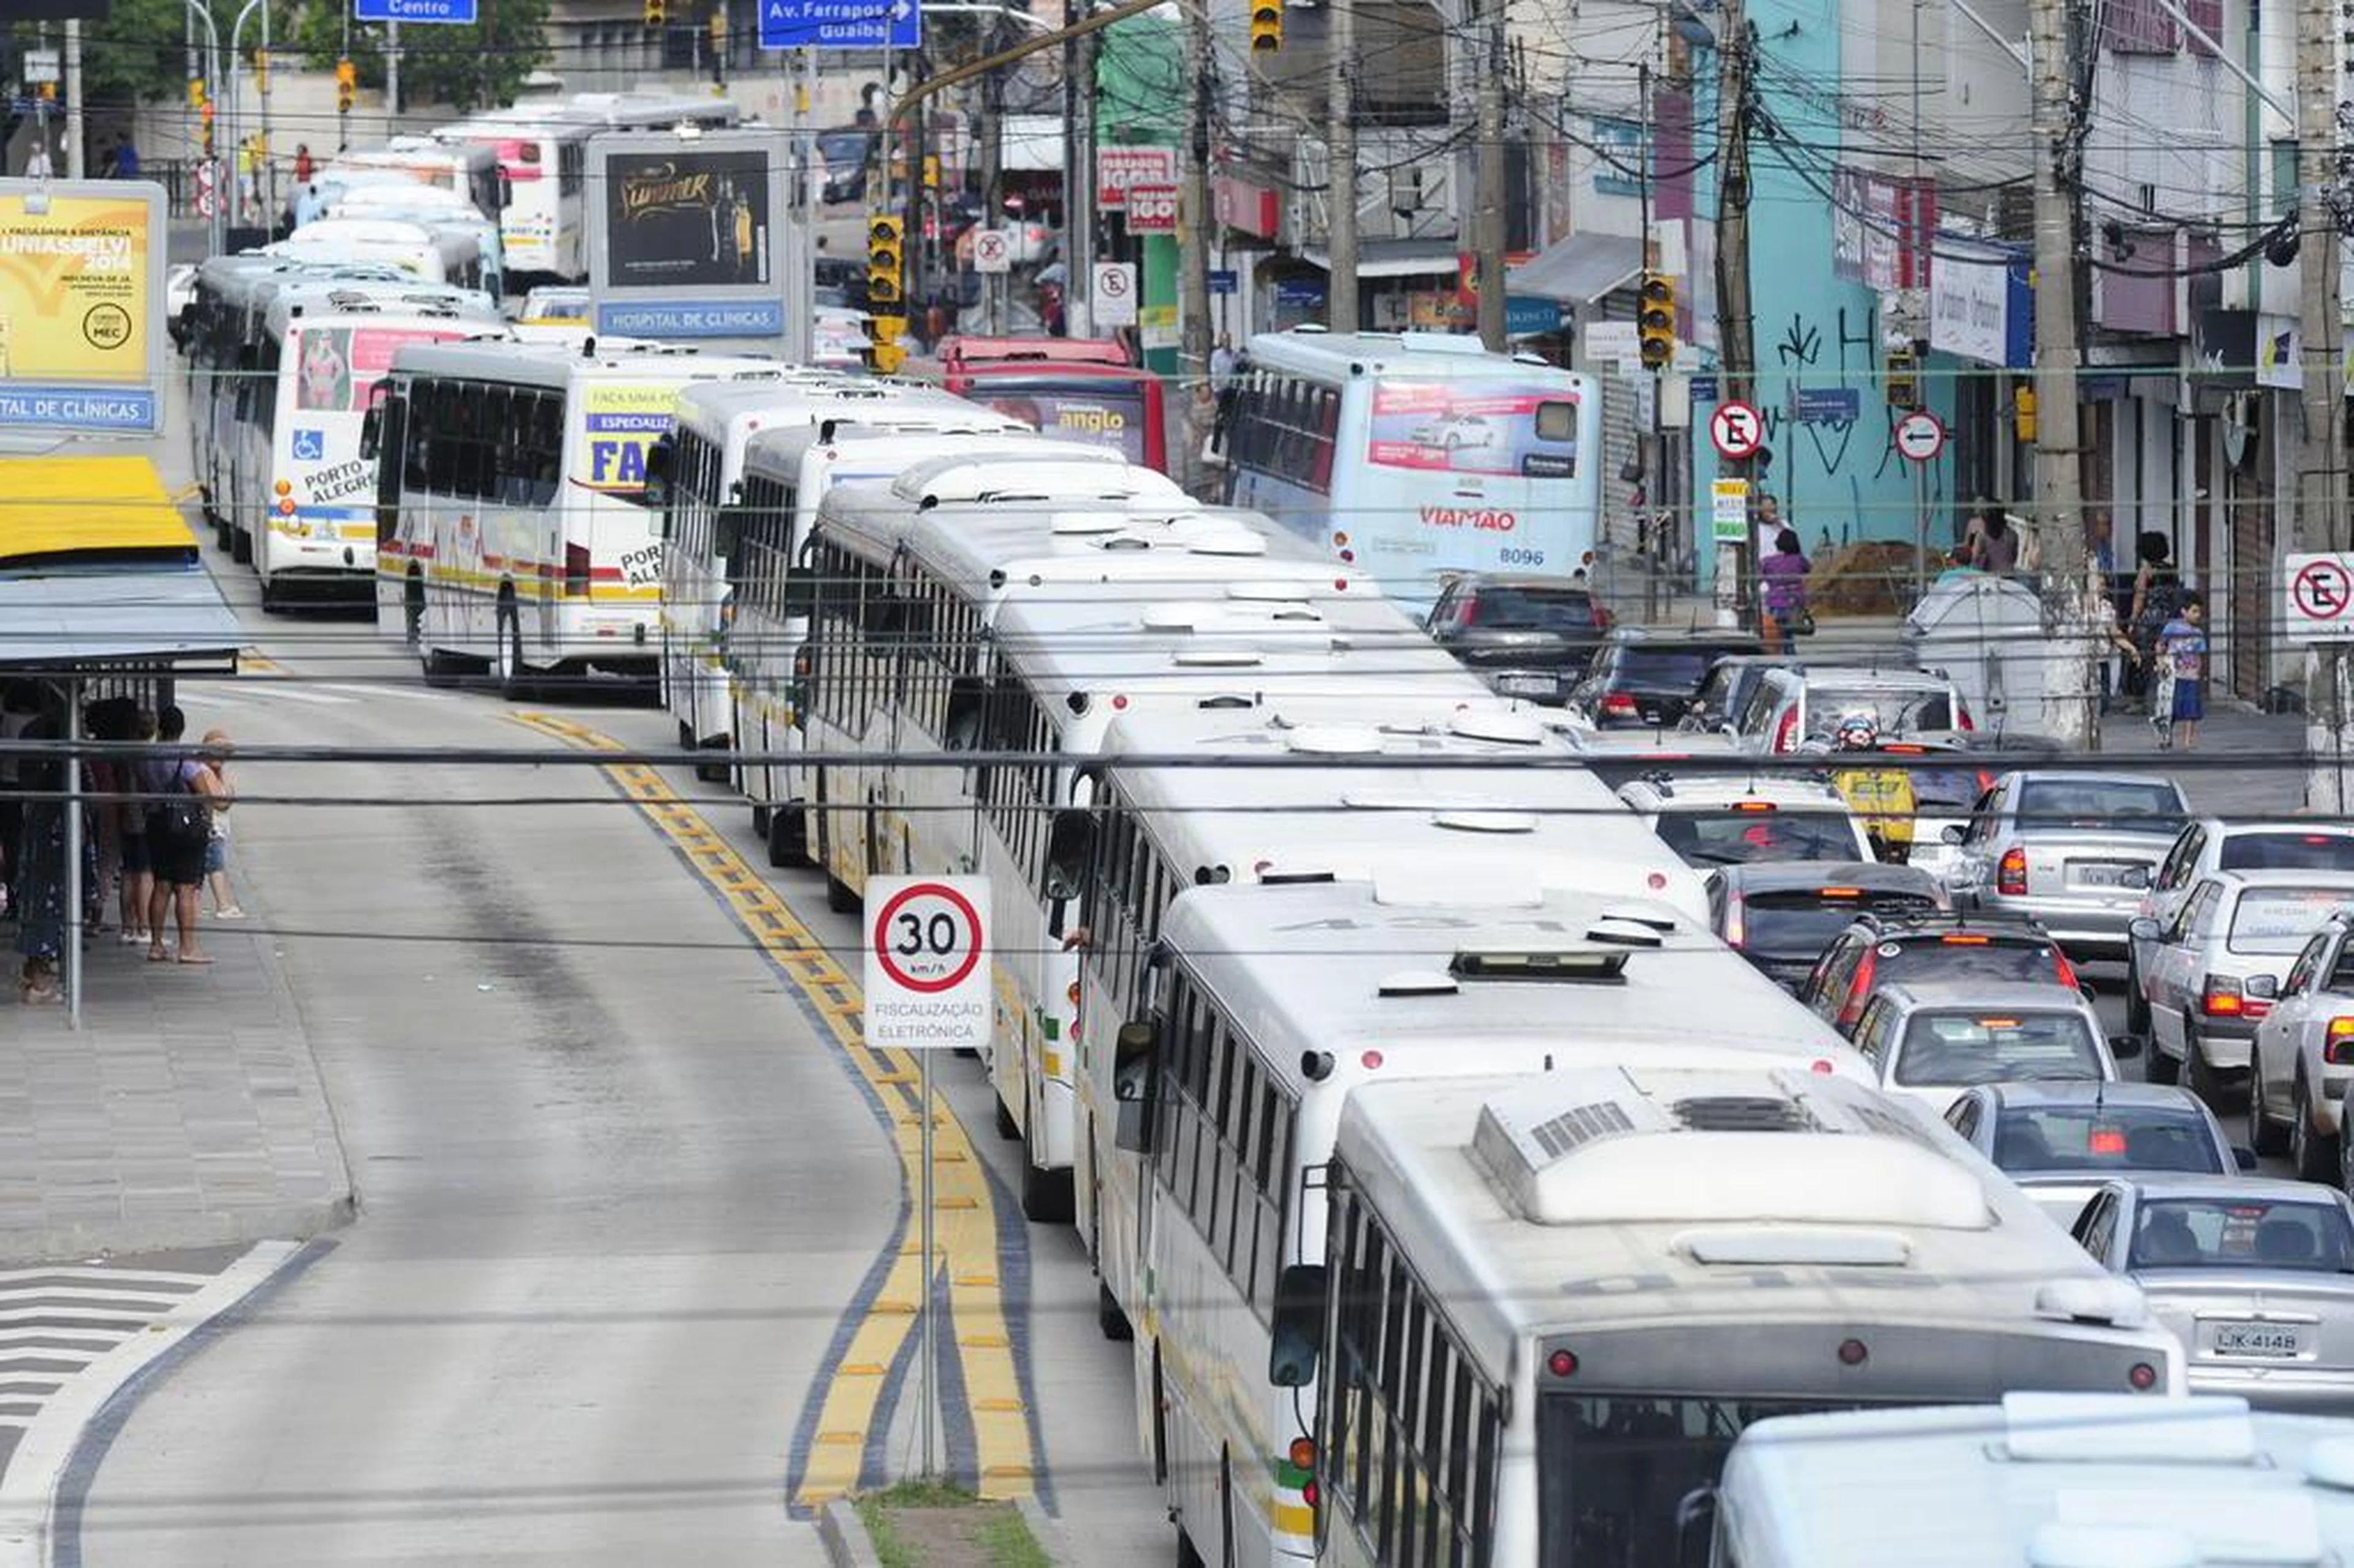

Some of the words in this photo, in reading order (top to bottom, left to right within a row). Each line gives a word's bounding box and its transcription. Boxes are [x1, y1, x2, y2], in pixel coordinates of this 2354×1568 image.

[389, 0, 449, 15] Centro
[769, 2, 799, 18] Av.
[803, 2, 885, 19] Farrapos
[613, 313, 677, 330] HOSPITAL
[683, 313, 702, 327] DE
[93, 327, 121, 338] MEC
[35, 400, 58, 416] DE
[1059, 410, 1124, 431] anglo
[305, 460, 363, 489] PORTO
[313, 473, 374, 504] ALEGR
[1499, 548, 1545, 566] 8096
[896, 912, 956, 956] 30
[910, 963, 946, 974] km/h
[875, 1002, 983, 1018] FISCALIZAÇÃO
[877, 1022, 974, 1038] ELETRÔNICA
